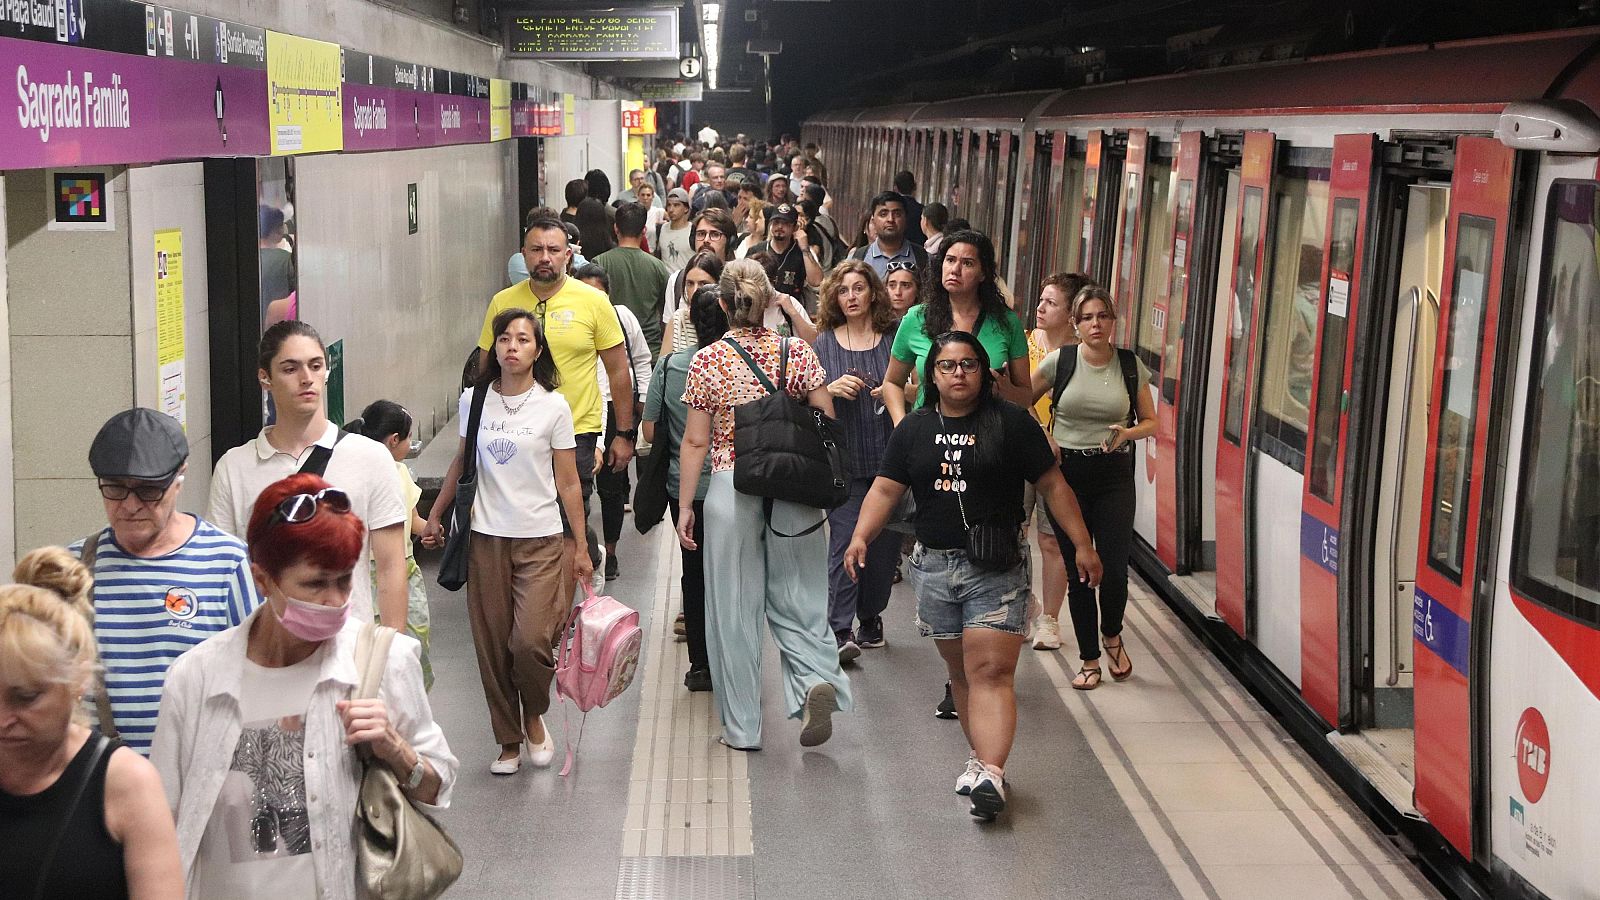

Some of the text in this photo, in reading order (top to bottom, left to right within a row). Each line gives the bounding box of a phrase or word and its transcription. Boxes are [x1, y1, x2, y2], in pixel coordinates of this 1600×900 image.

[17, 65, 130, 142] Sagrada Família
[935, 433, 976, 446] FOCUS
[934, 479, 967, 492] GOOD
